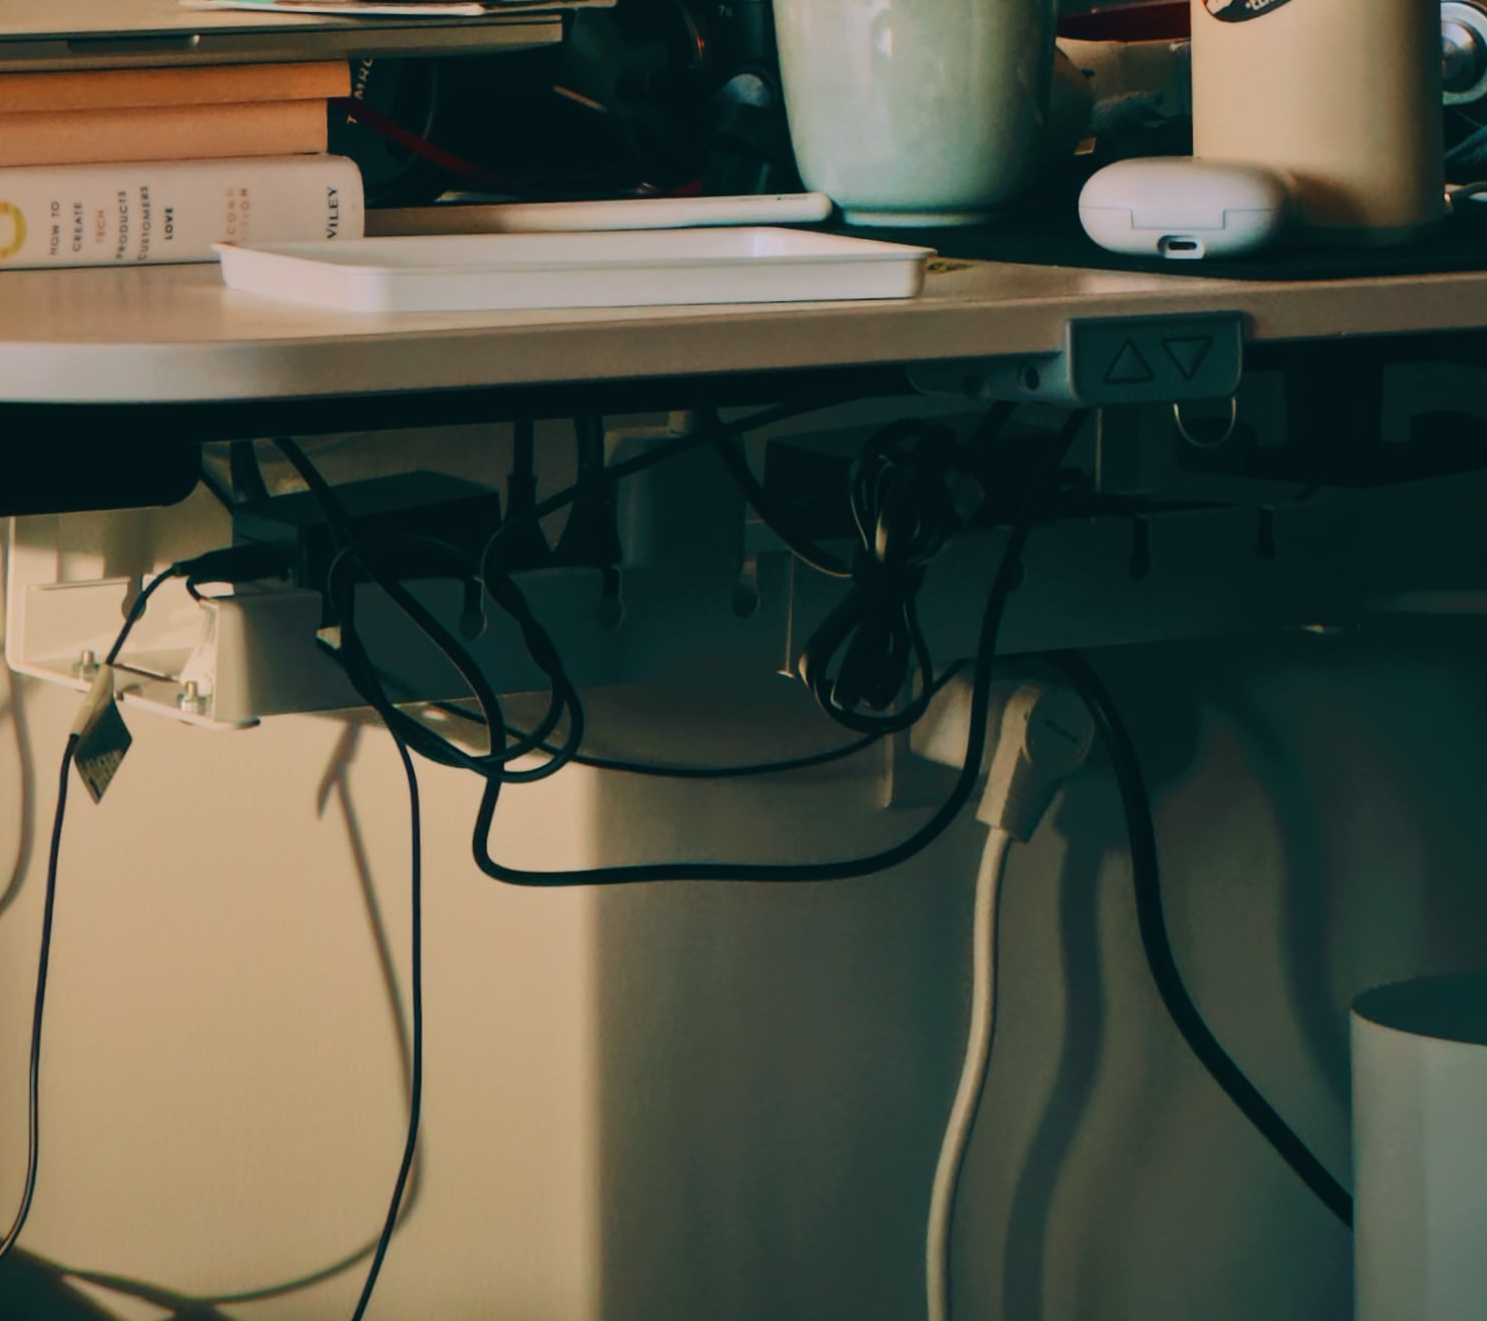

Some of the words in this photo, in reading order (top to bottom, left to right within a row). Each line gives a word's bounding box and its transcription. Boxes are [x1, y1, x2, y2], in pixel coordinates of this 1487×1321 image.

[50, 200, 61, 218] TO
[95, 209, 106, 244] TECH
[115, 189, 129, 260] PRODUCTS
[136, 185, 152, 261] CUSTOMERS
[164, 206, 175, 241] LOVE
[49, 224, 61, 256] HOW
[72, 201, 84, 253] CREATE
